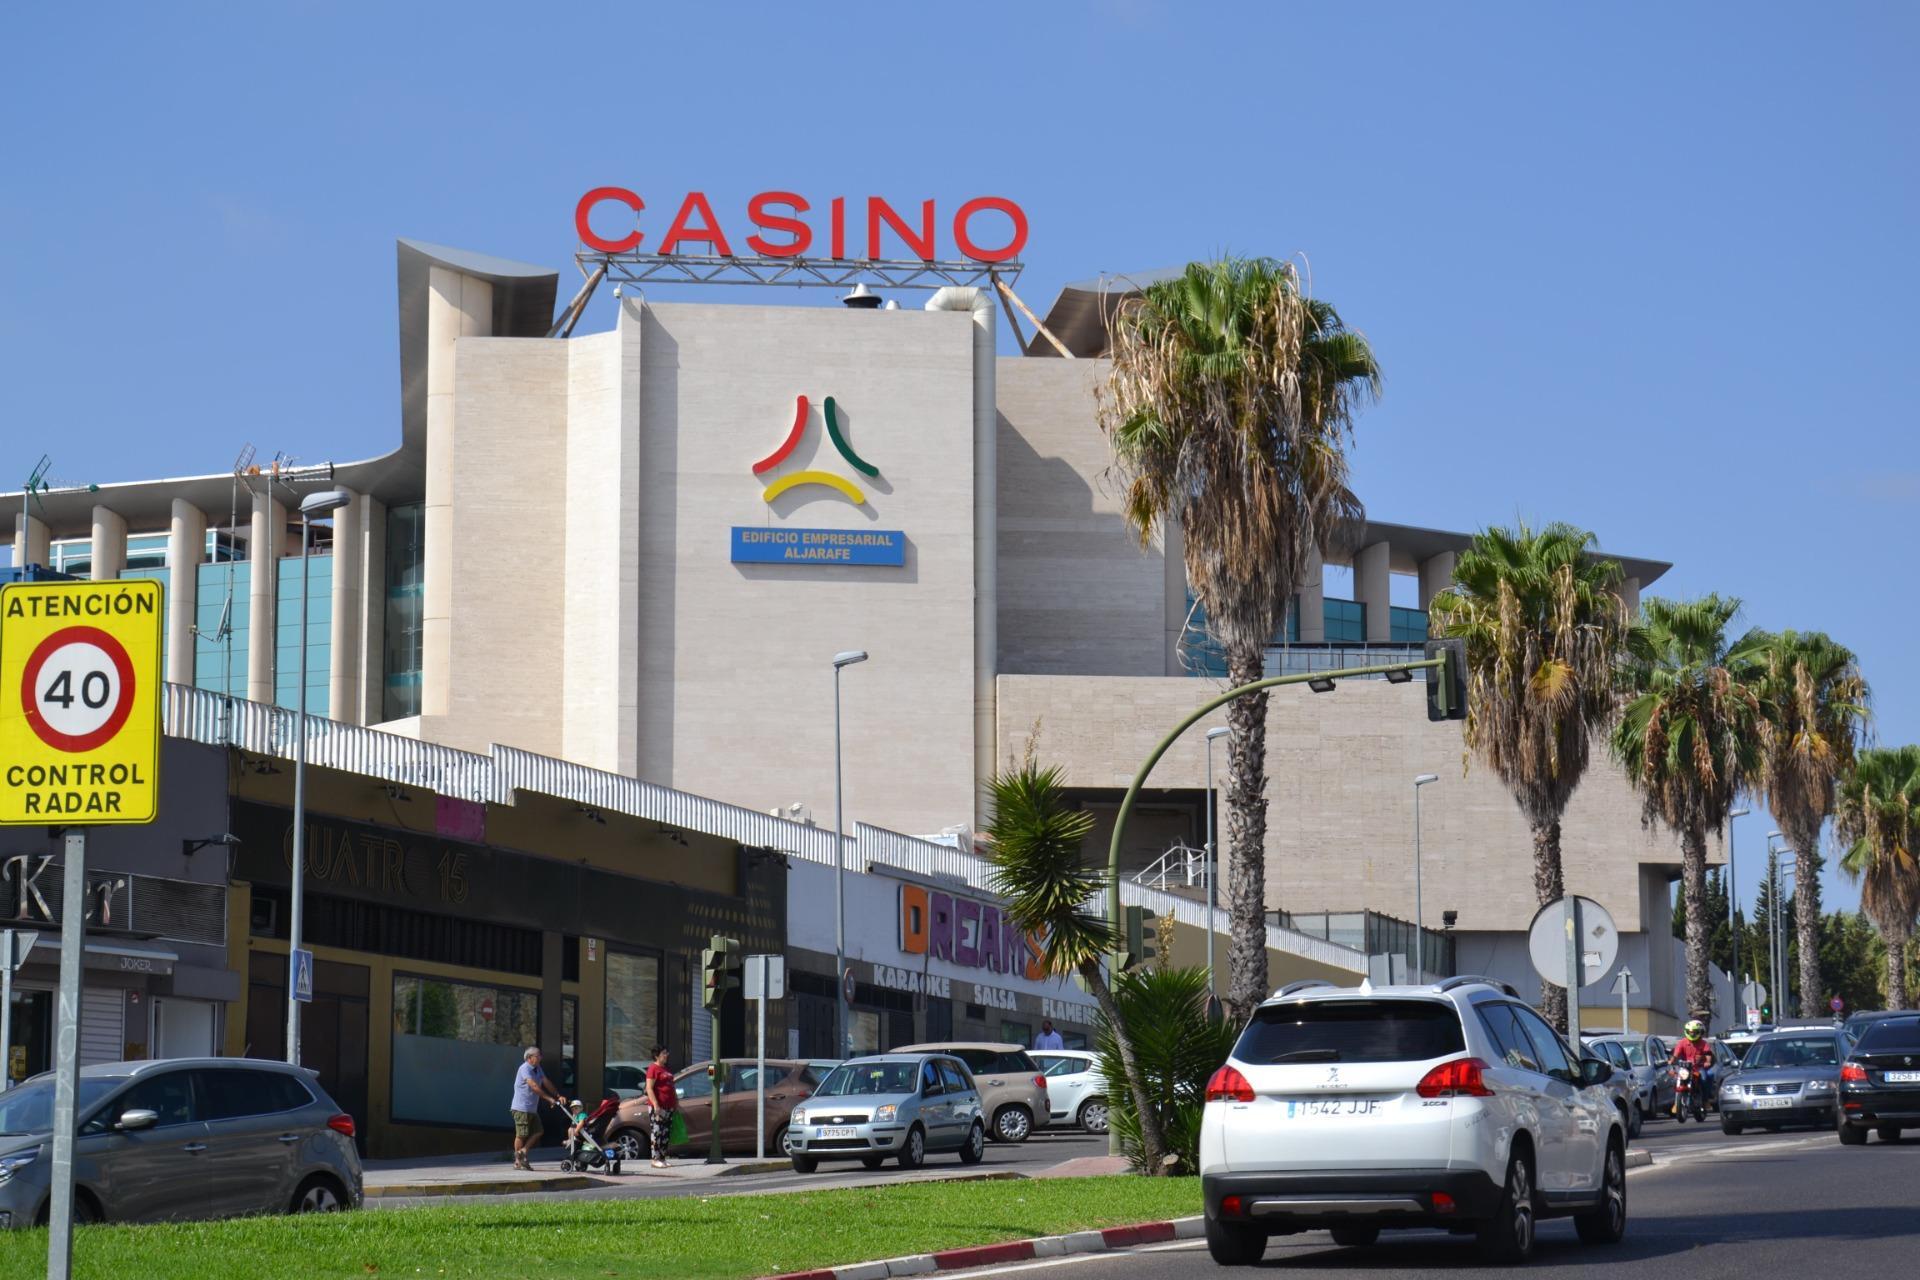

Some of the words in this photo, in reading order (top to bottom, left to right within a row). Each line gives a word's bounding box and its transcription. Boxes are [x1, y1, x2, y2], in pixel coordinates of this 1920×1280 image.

[575, 186, 1029, 263] CASINO
[741, 531, 799, 544] EDIFICIO
[802, 532, 893, 546] EMPRESARIAL
[784, 547, 850, 560] ALJARAFE
[6, 588, 154, 618] ATENCIÓN
[44, 670, 110, 709] 40
[6, 763, 145, 787] CONTROL
[25, 792, 121, 814] RADAR
[899, 883, 1050, 981] DREAMS
[120, 957, 153, 972] JOKER
[873, 964, 950, 999] KARAOKE
[974, 985, 1017, 1012] SALSA
[1042, 998, 1097, 1026] FLAMEN
[1301, 1099, 1341, 1115] 1542
[1347, 1099, 1380, 1115] JJF
[823, 1128, 840, 1137] 9775
